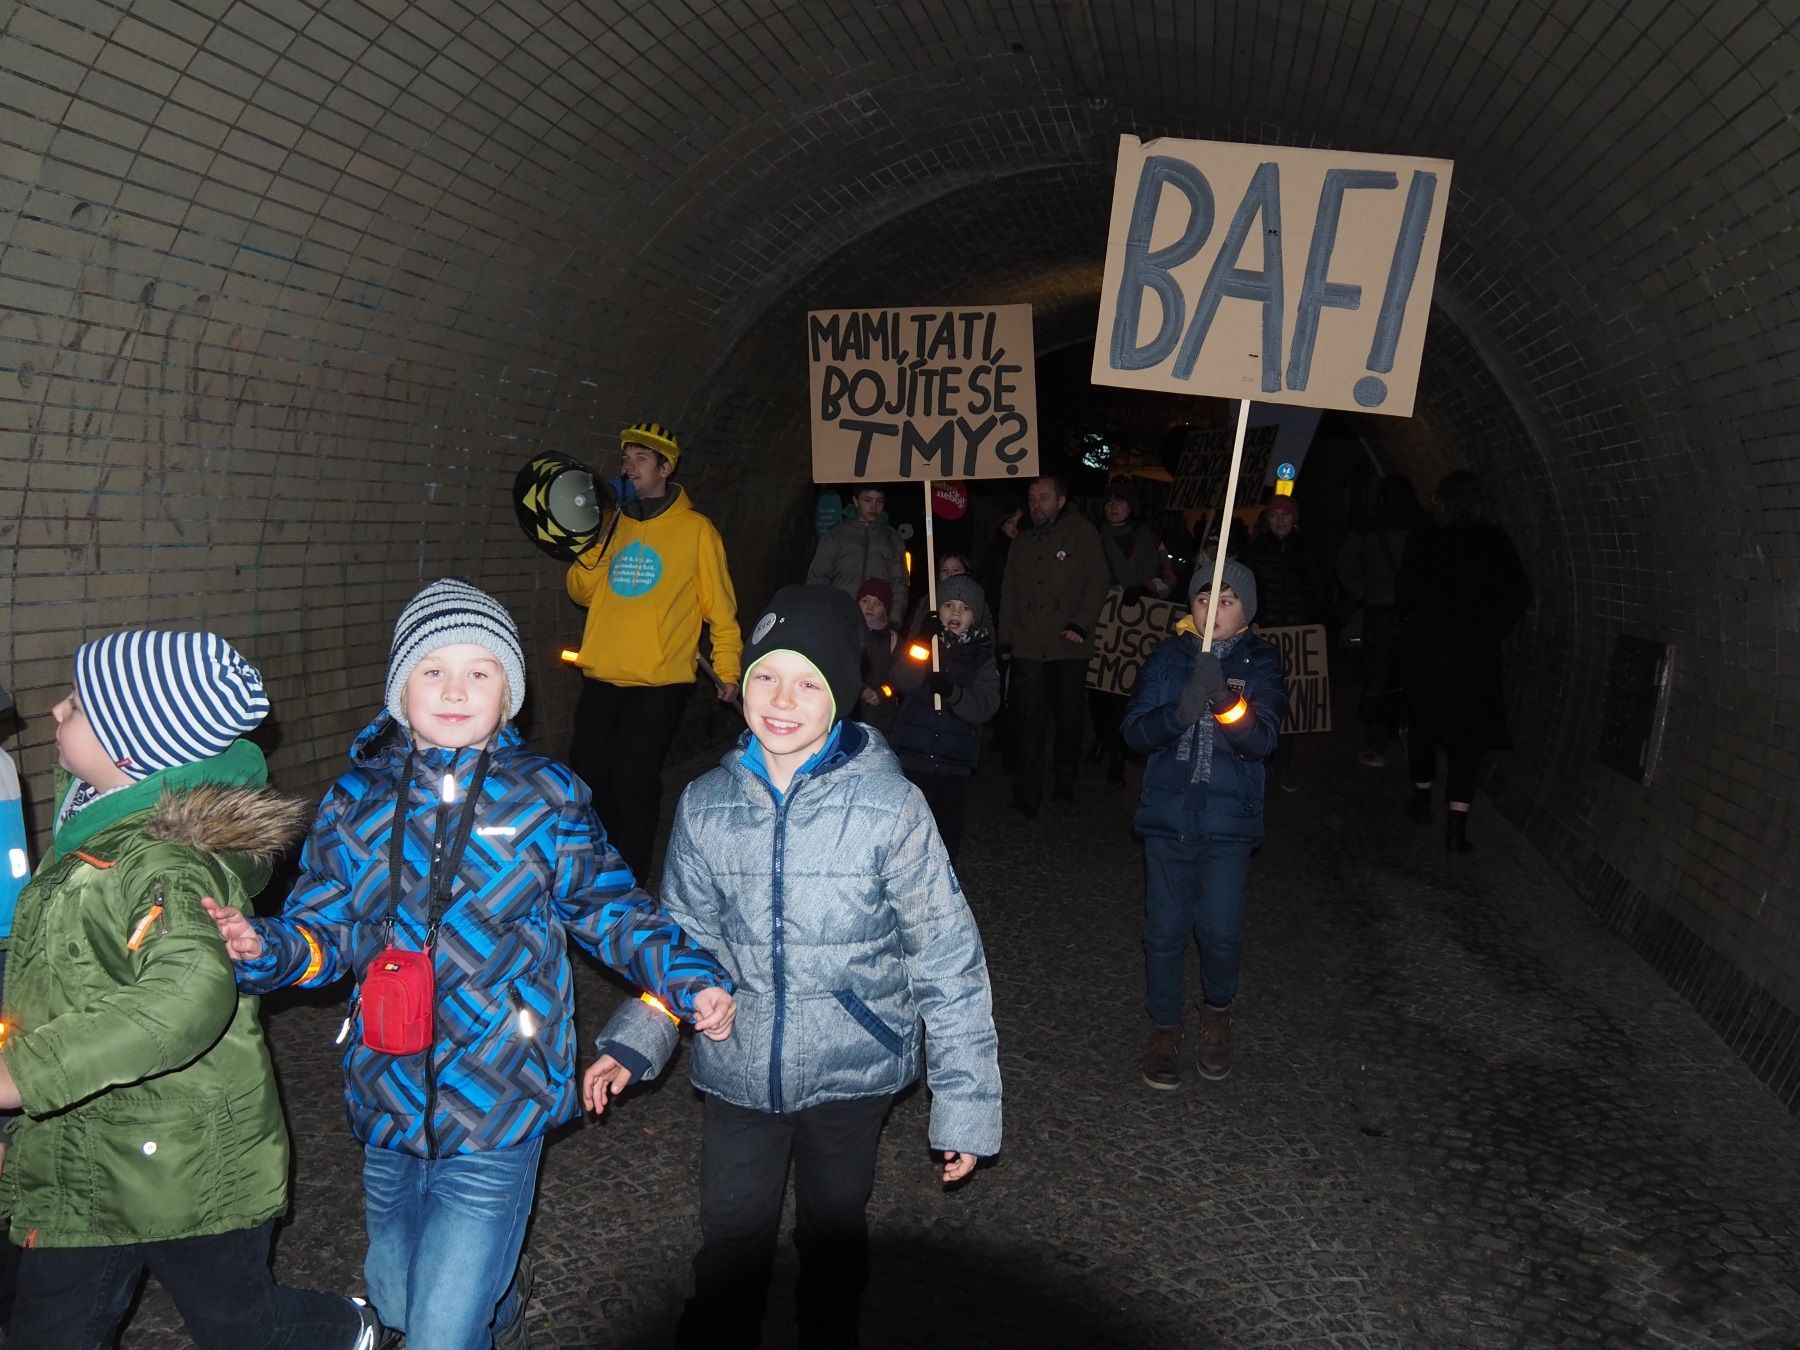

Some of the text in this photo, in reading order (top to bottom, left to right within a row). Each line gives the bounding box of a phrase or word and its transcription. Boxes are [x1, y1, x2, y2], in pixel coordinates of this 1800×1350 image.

[1110, 155, 1437, 407] BAF!
[810, 311, 1005, 365] MAMI, TATI,
[821, 358, 1022, 421] BOJÍTE SE
[839, 411, 1028, 477] TMY?
